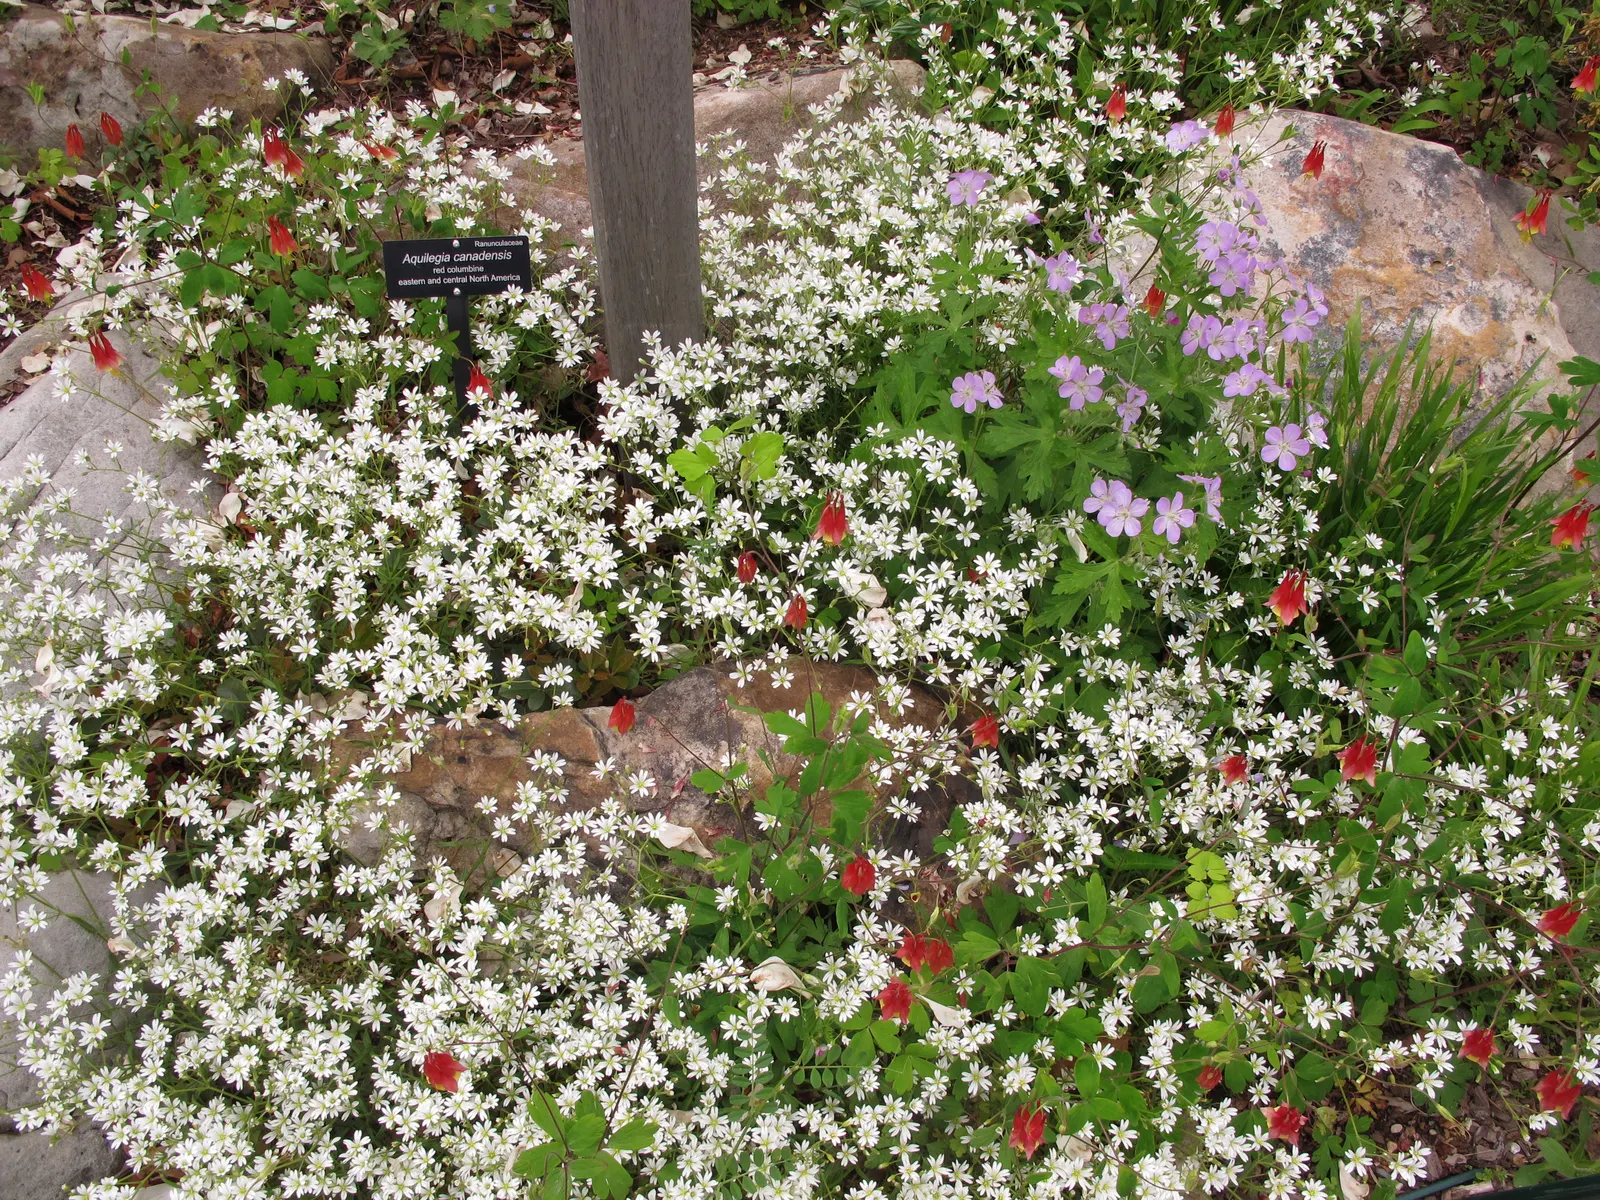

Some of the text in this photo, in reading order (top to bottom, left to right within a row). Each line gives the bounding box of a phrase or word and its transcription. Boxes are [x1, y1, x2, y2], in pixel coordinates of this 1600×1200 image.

[474, 240, 523, 248] Ranunculaceae
[402, 250, 512, 266] Aquilegia canadensis
[433, 265, 485, 274] red columbine
[398, 273, 521, 286] eastern and central North America
